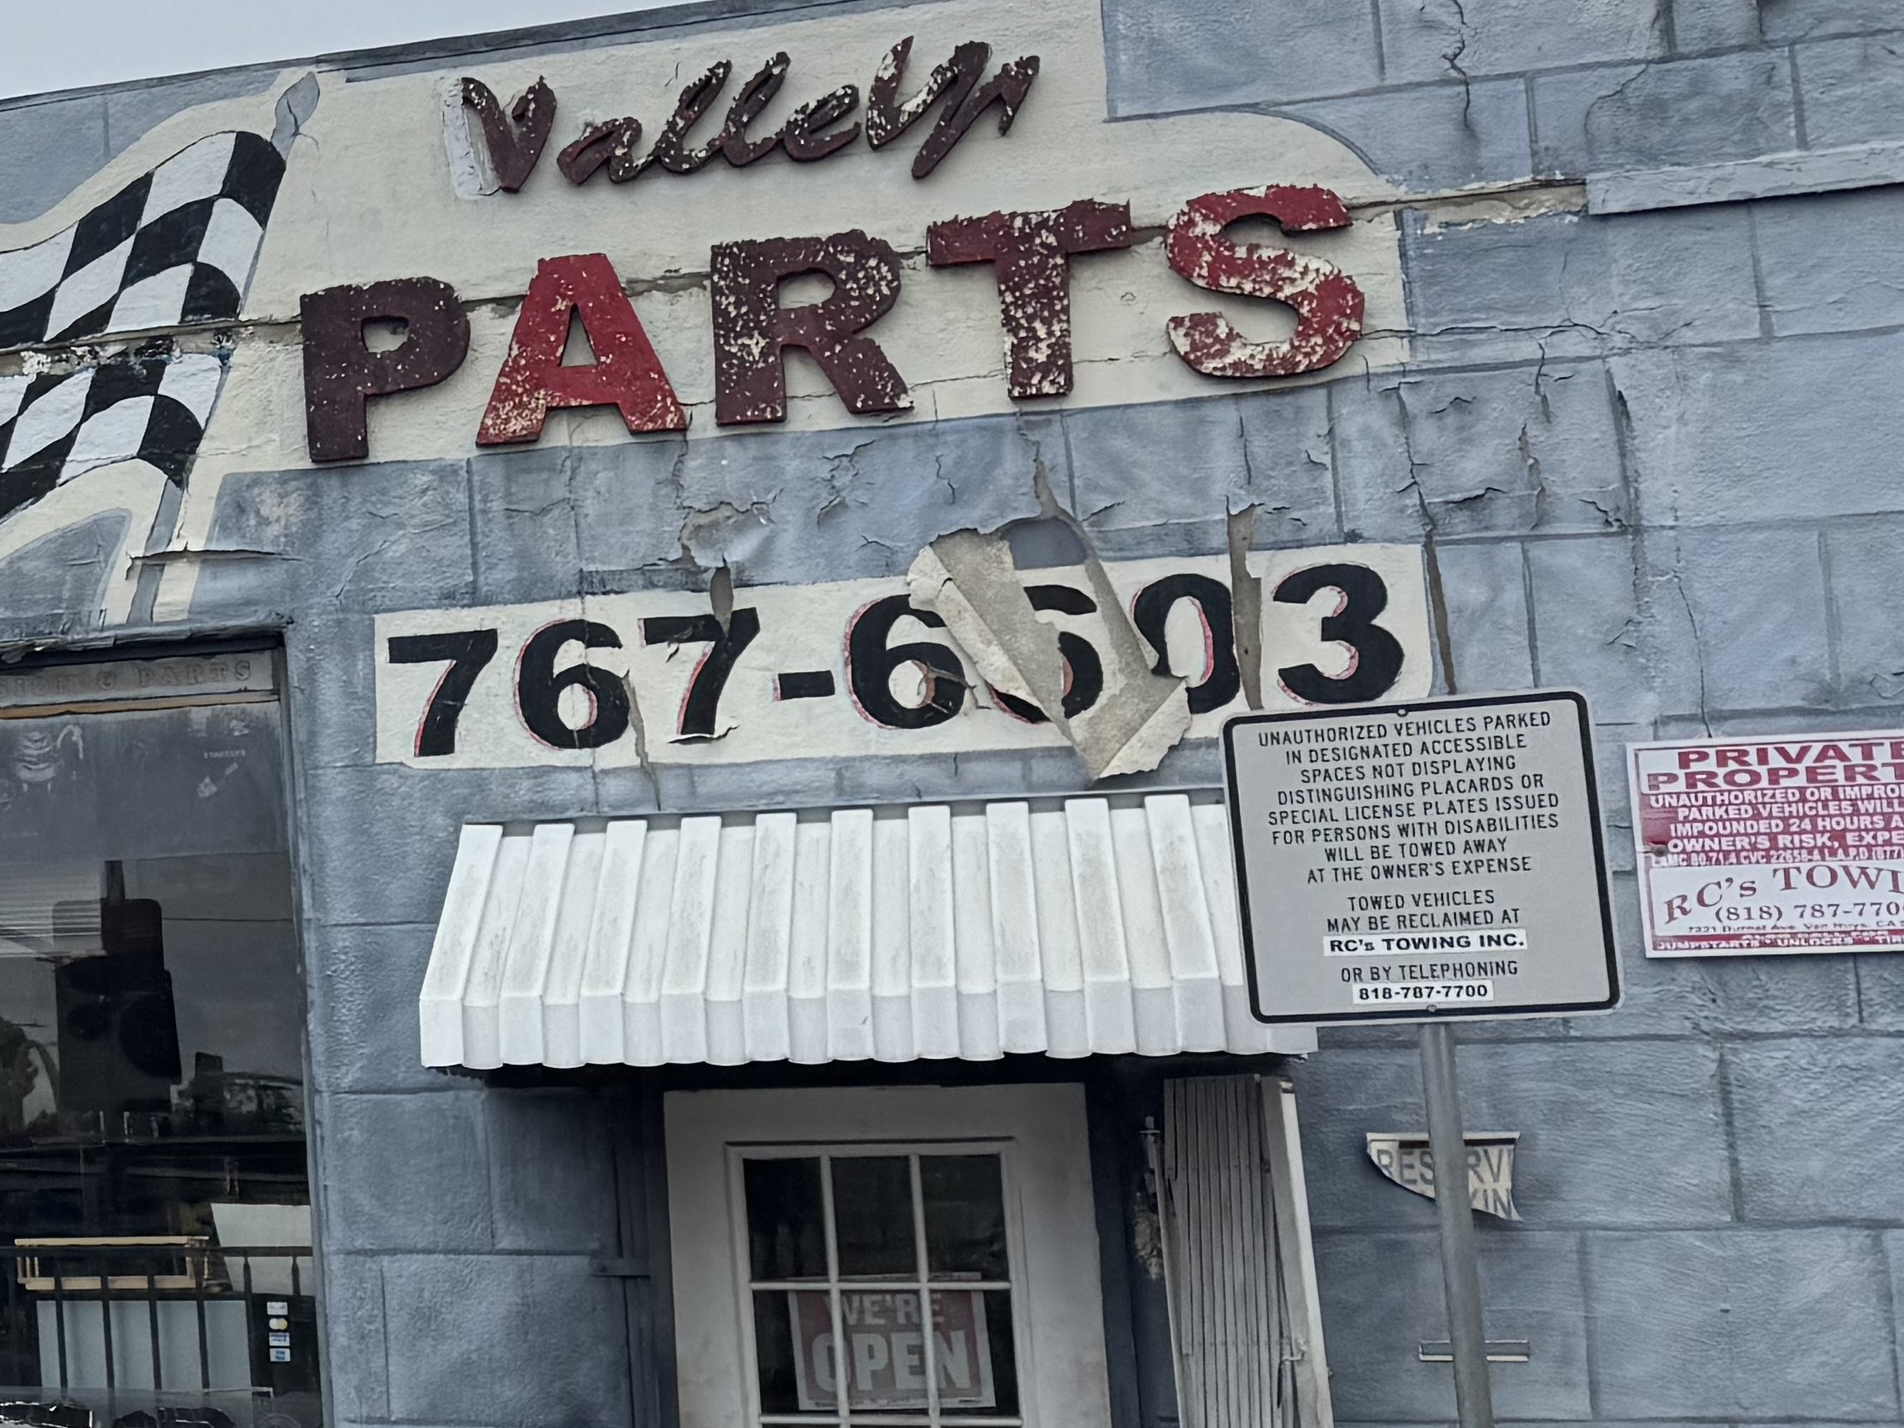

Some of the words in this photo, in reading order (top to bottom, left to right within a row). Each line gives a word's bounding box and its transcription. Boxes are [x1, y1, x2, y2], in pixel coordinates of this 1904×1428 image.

[298, 184, 1366, 463] PARTS
[1259, 724, 1387, 746] UNAUTHORIZED
[1394, 717, 1476, 737] VEHICLES
[1484, 712, 1550, 730] PARKED
[1286, 750, 1302, 765] IN
[1309, 744, 1413, 763] DESIGNATED
[1421, 734, 1527, 755] ACCESSIBLE
[1301, 766, 1365, 783] SPACES
[1372, 763, 1405, 778] NOT
[1412, 756, 1516, 776] DISPLAYING
[1647, 762, 1904, 791] PROPERT
[1278, 783, 1413, 805] DISTINGUISHING
[1421, 776, 1514, 795] PLACARDS
[1522, 775, 1544, 789] OR
[1650, 788, 1800, 807] UNAUTHORIZED
[1806, 786, 1832, 800] OR
[1839, 784, 1904, 799] IMPRO
[1268, 808, 1338, 825] SPECIAL
[1345, 803, 1415, 821] LICENSE
[1423, 798, 1488, 816] PLATES
[1495, 794, 1559, 811] ISSUED
[1678, 806, 1752, 821] PARKED
[1758, 802, 1852, 818] VEHICLES
[1272, 830, 1305, 845] FOR
[1312, 826, 1390, 843] PERSONS
[1398, 823, 1438, 838] WITH
[1445, 814, 1559, 835] DISABILITIES
[1670, 821, 1783, 837] IMPOUNDED
[1789, 818, 1811, 831] 24
[1817, 816, 1884, 830] HOURS
[1325, 847, 1363, 862] WILL
[1371, 845, 1392, 859] BE
[1399, 841, 1456, 857] TOWED
[1463, 838, 1508, 854] AWAY
[1668, 835, 1770, 852] OWNER'S
[1777, 834, 1839, 849] RISK,
[1846, 831, 1904, 845] EXPE
[1740, 851, 1767, 863] CVC
[1307, 869, 1325, 883] AT
[1332, 866, 1363, 881] THE
[1371, 863, 1445, 880] OWNER'S
[1452, 857, 1531, 875] EXPENSE
[1348, 895, 1405, 912] TOWED
[1411, 890, 1494, 908] VEHICLES
[1664, 876, 1757, 924] RC's
[1772, 864, 1904, 894] TOWI
[1327, 917, 1361, 933] MAY
[1368, 915, 1390, 930] BE
[1397, 911, 1494, 929] RECLAIMED
[1501, 909, 1519, 923] AT
[1715, 905, 1783, 923] (818)
[1794, 901, 1904, 919] 787-770
[1382, 936, 1471, 951] TOWING
[1479, 933, 1524, 948] INC.
[1341, 967, 1364, 982] OR
[1371, 967, 1391, 981] BY
[1398, 961, 1518, 980] TELEPHONING
[1359, 984, 1488, 1000] 818-787-7700
[812, 1330, 971, 1393] OPEN
